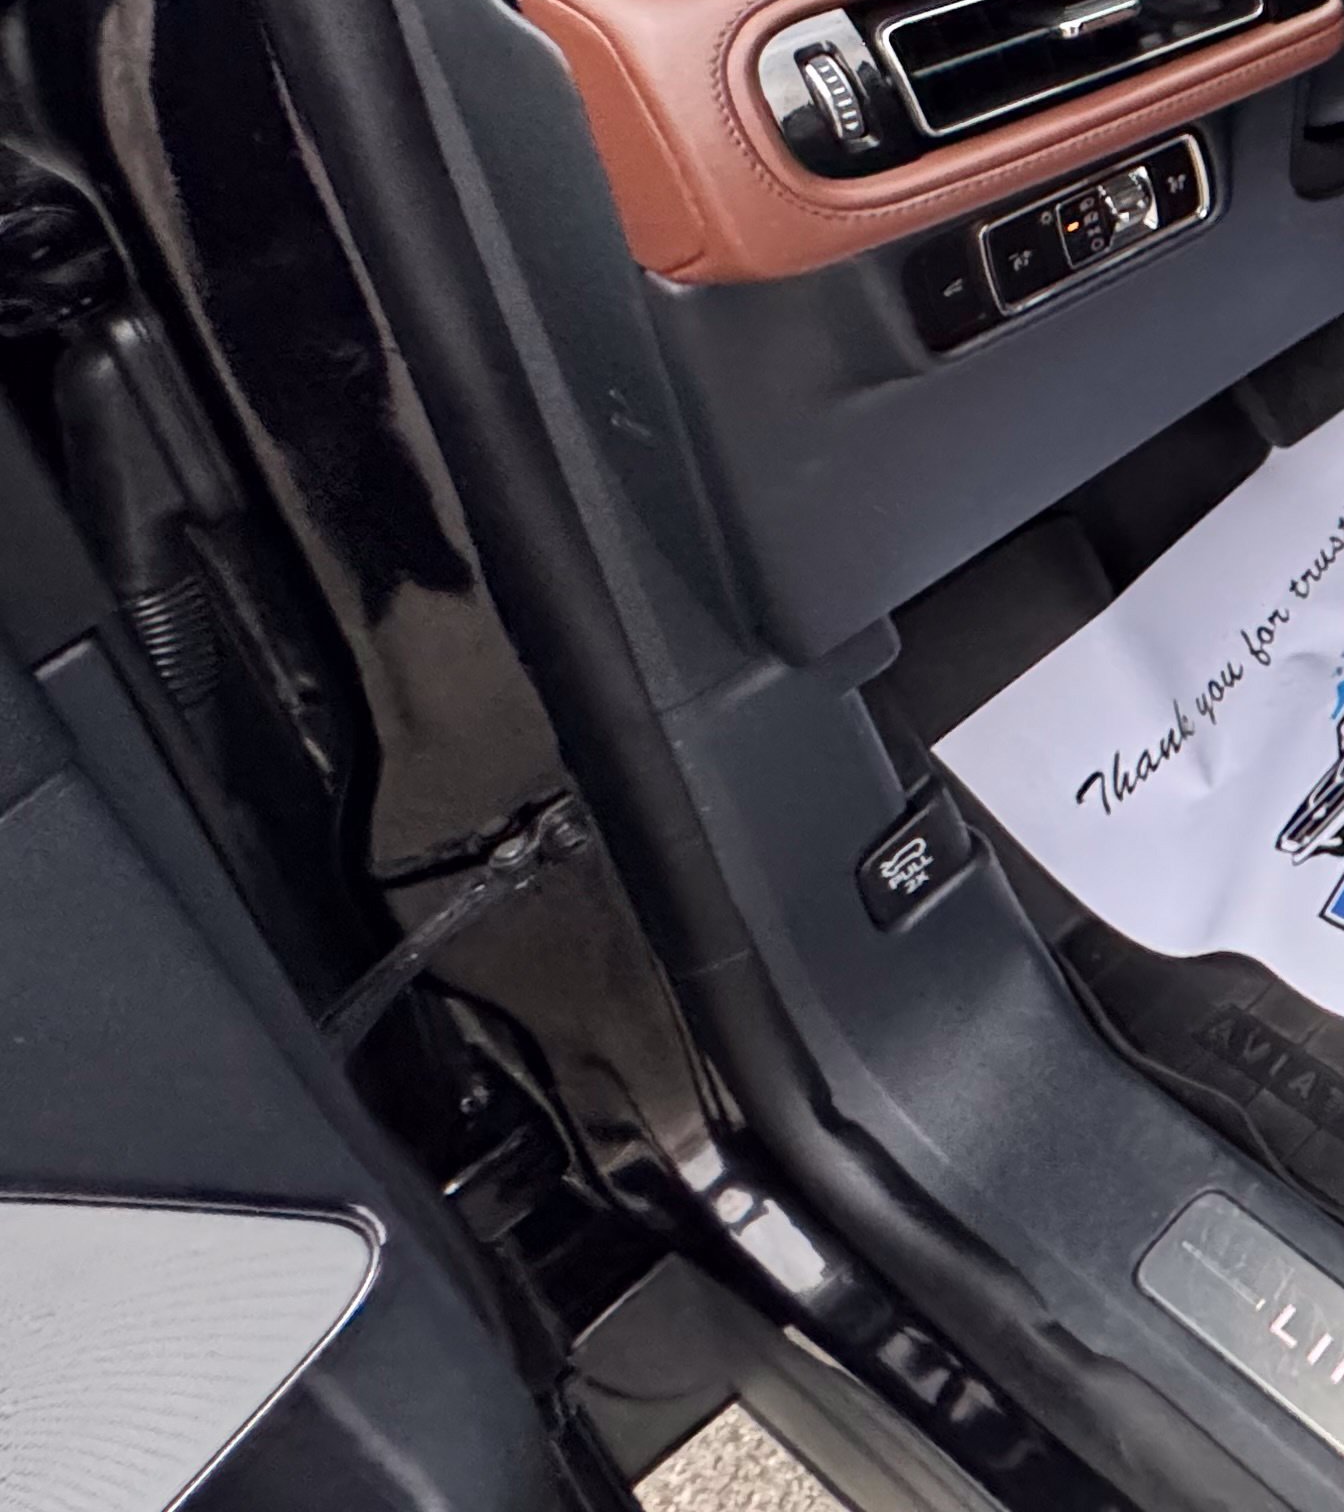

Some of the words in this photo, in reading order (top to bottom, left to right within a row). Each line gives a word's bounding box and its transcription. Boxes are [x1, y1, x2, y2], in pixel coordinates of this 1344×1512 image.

[1075, 698, 1196, 816] Thank
[1195, 661, 1244, 725] you
[1240, 607, 1291, 667] for
[888, 854, 935, 890] PULL
